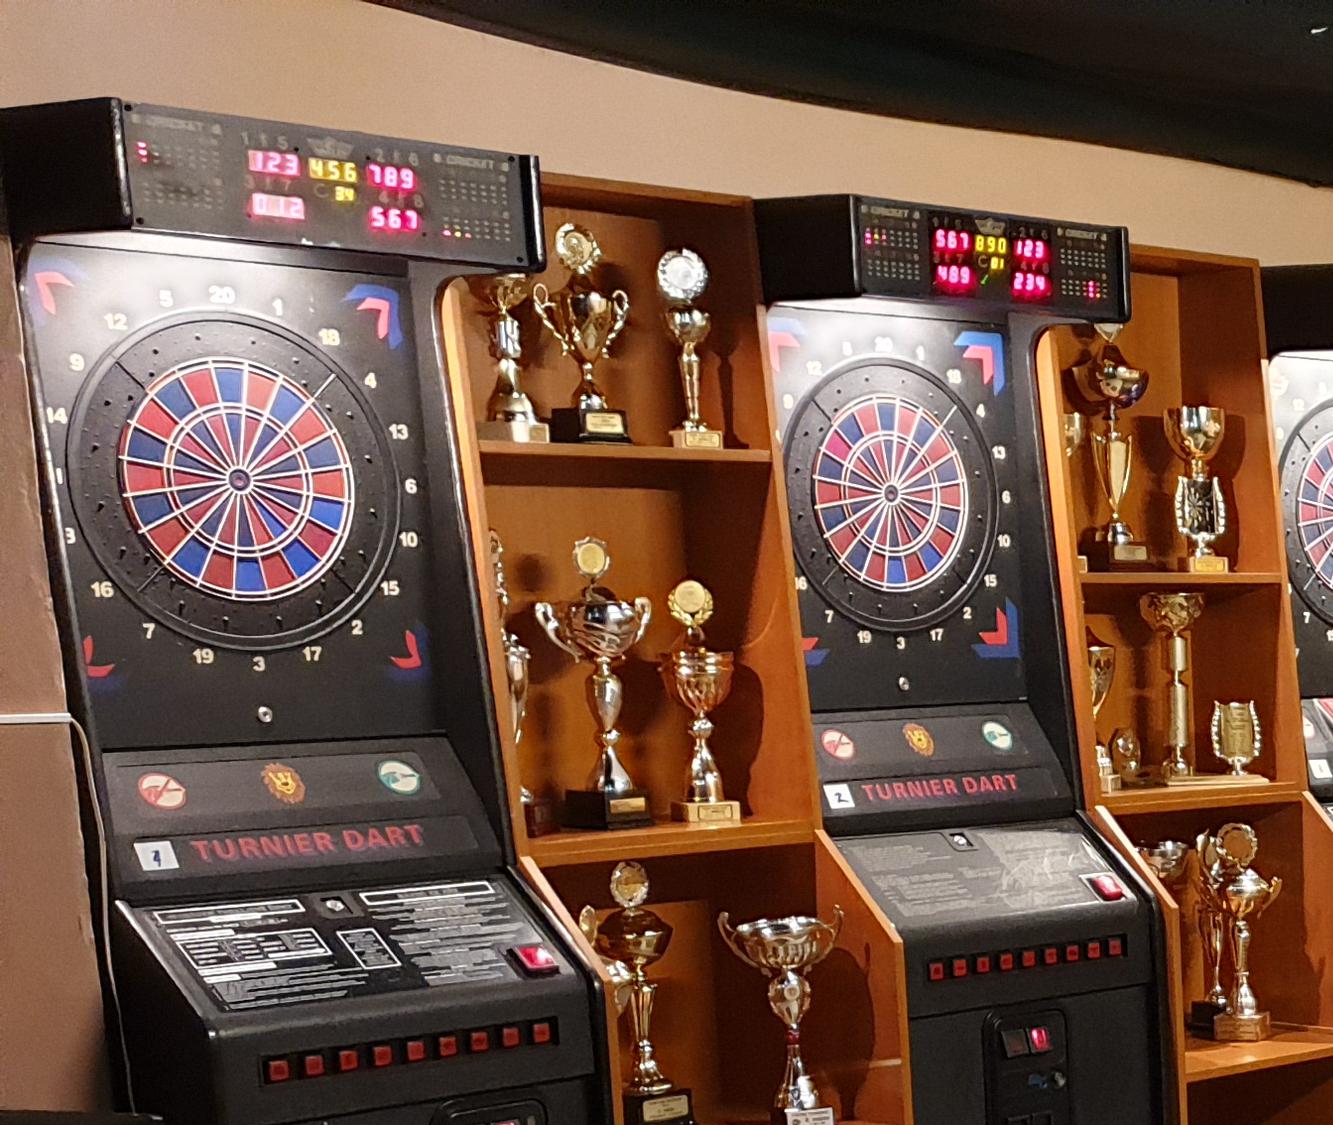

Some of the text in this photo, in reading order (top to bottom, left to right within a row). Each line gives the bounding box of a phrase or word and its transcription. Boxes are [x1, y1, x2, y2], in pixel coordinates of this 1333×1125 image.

[254, 150, 414, 189] 123 456 789
[253, 195, 304, 219] 012
[370, 206, 418, 229] 567
[935, 229, 1044, 258] 567 890 123
[1013, 272, 1045, 291] 234
[159, 289, 174, 308] 5
[209, 285, 236, 305] 20
[272, 298, 283, 316] 1
[104, 313, 128, 331] 12
[319, 328, 341, 346] 18
[69, 353, 85, 371] 9
[364, 372, 377, 389] 4
[47, 407, 68, 425] 14
[976, 403, 986, 418] 4
[389, 423, 408, 440] 13
[992, 446, 1006, 460] 13
[405, 478, 417, 494] 6
[1002, 490, 1011, 504] 6
[398, 531, 418, 548] 10
[997, 534, 1011, 548] 10
[380, 580, 400, 596] 15
[983, 575, 998, 588] 15
[91, 582, 114, 598] 16
[824, 610, 834, 623] 7
[962, 607, 972, 620] 2
[1303, 611, 1311, 623] 7
[143, 623, 155, 639] 7
[351, 620, 363, 635] 2
[929, 628, 944, 641] 17
[857, 630, 872, 644] 19
[896, 637, 905, 650] 3
[193, 648, 214, 664] 19
[302, 646, 322, 662] 17
[253, 656, 265, 672] 3
[861, 774, 1017, 800] TURNIER DART
[834, 792, 849, 803] 2
[191, 823, 424, 864] TURNIER DART
